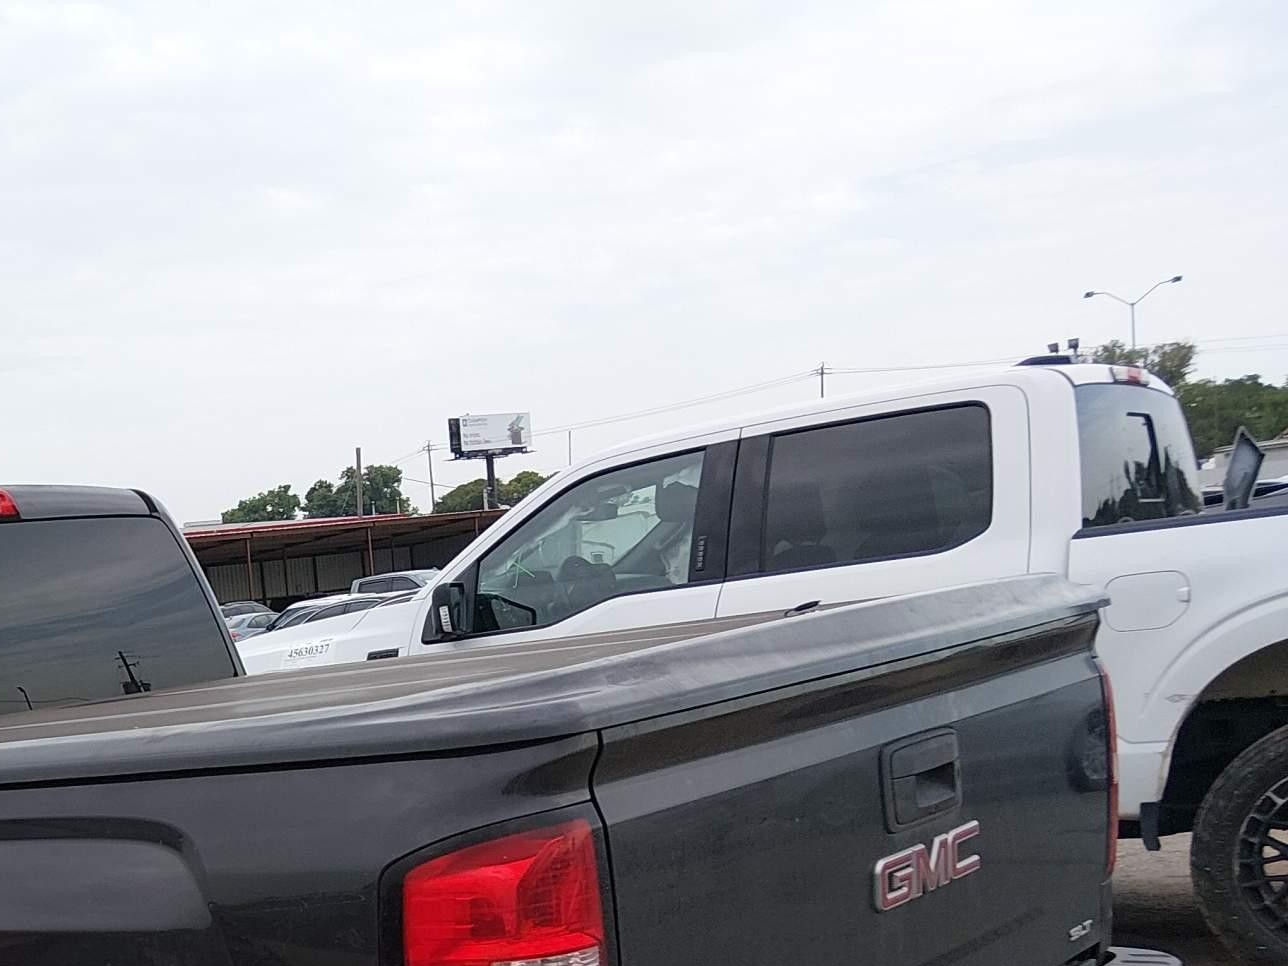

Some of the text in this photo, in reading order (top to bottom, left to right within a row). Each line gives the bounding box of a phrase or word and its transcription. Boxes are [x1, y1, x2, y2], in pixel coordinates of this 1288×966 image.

[287, 643, 330, 658] 45630327
[875, 819, 981, 911] GMC
[1069, 919, 1093, 941] SLT
